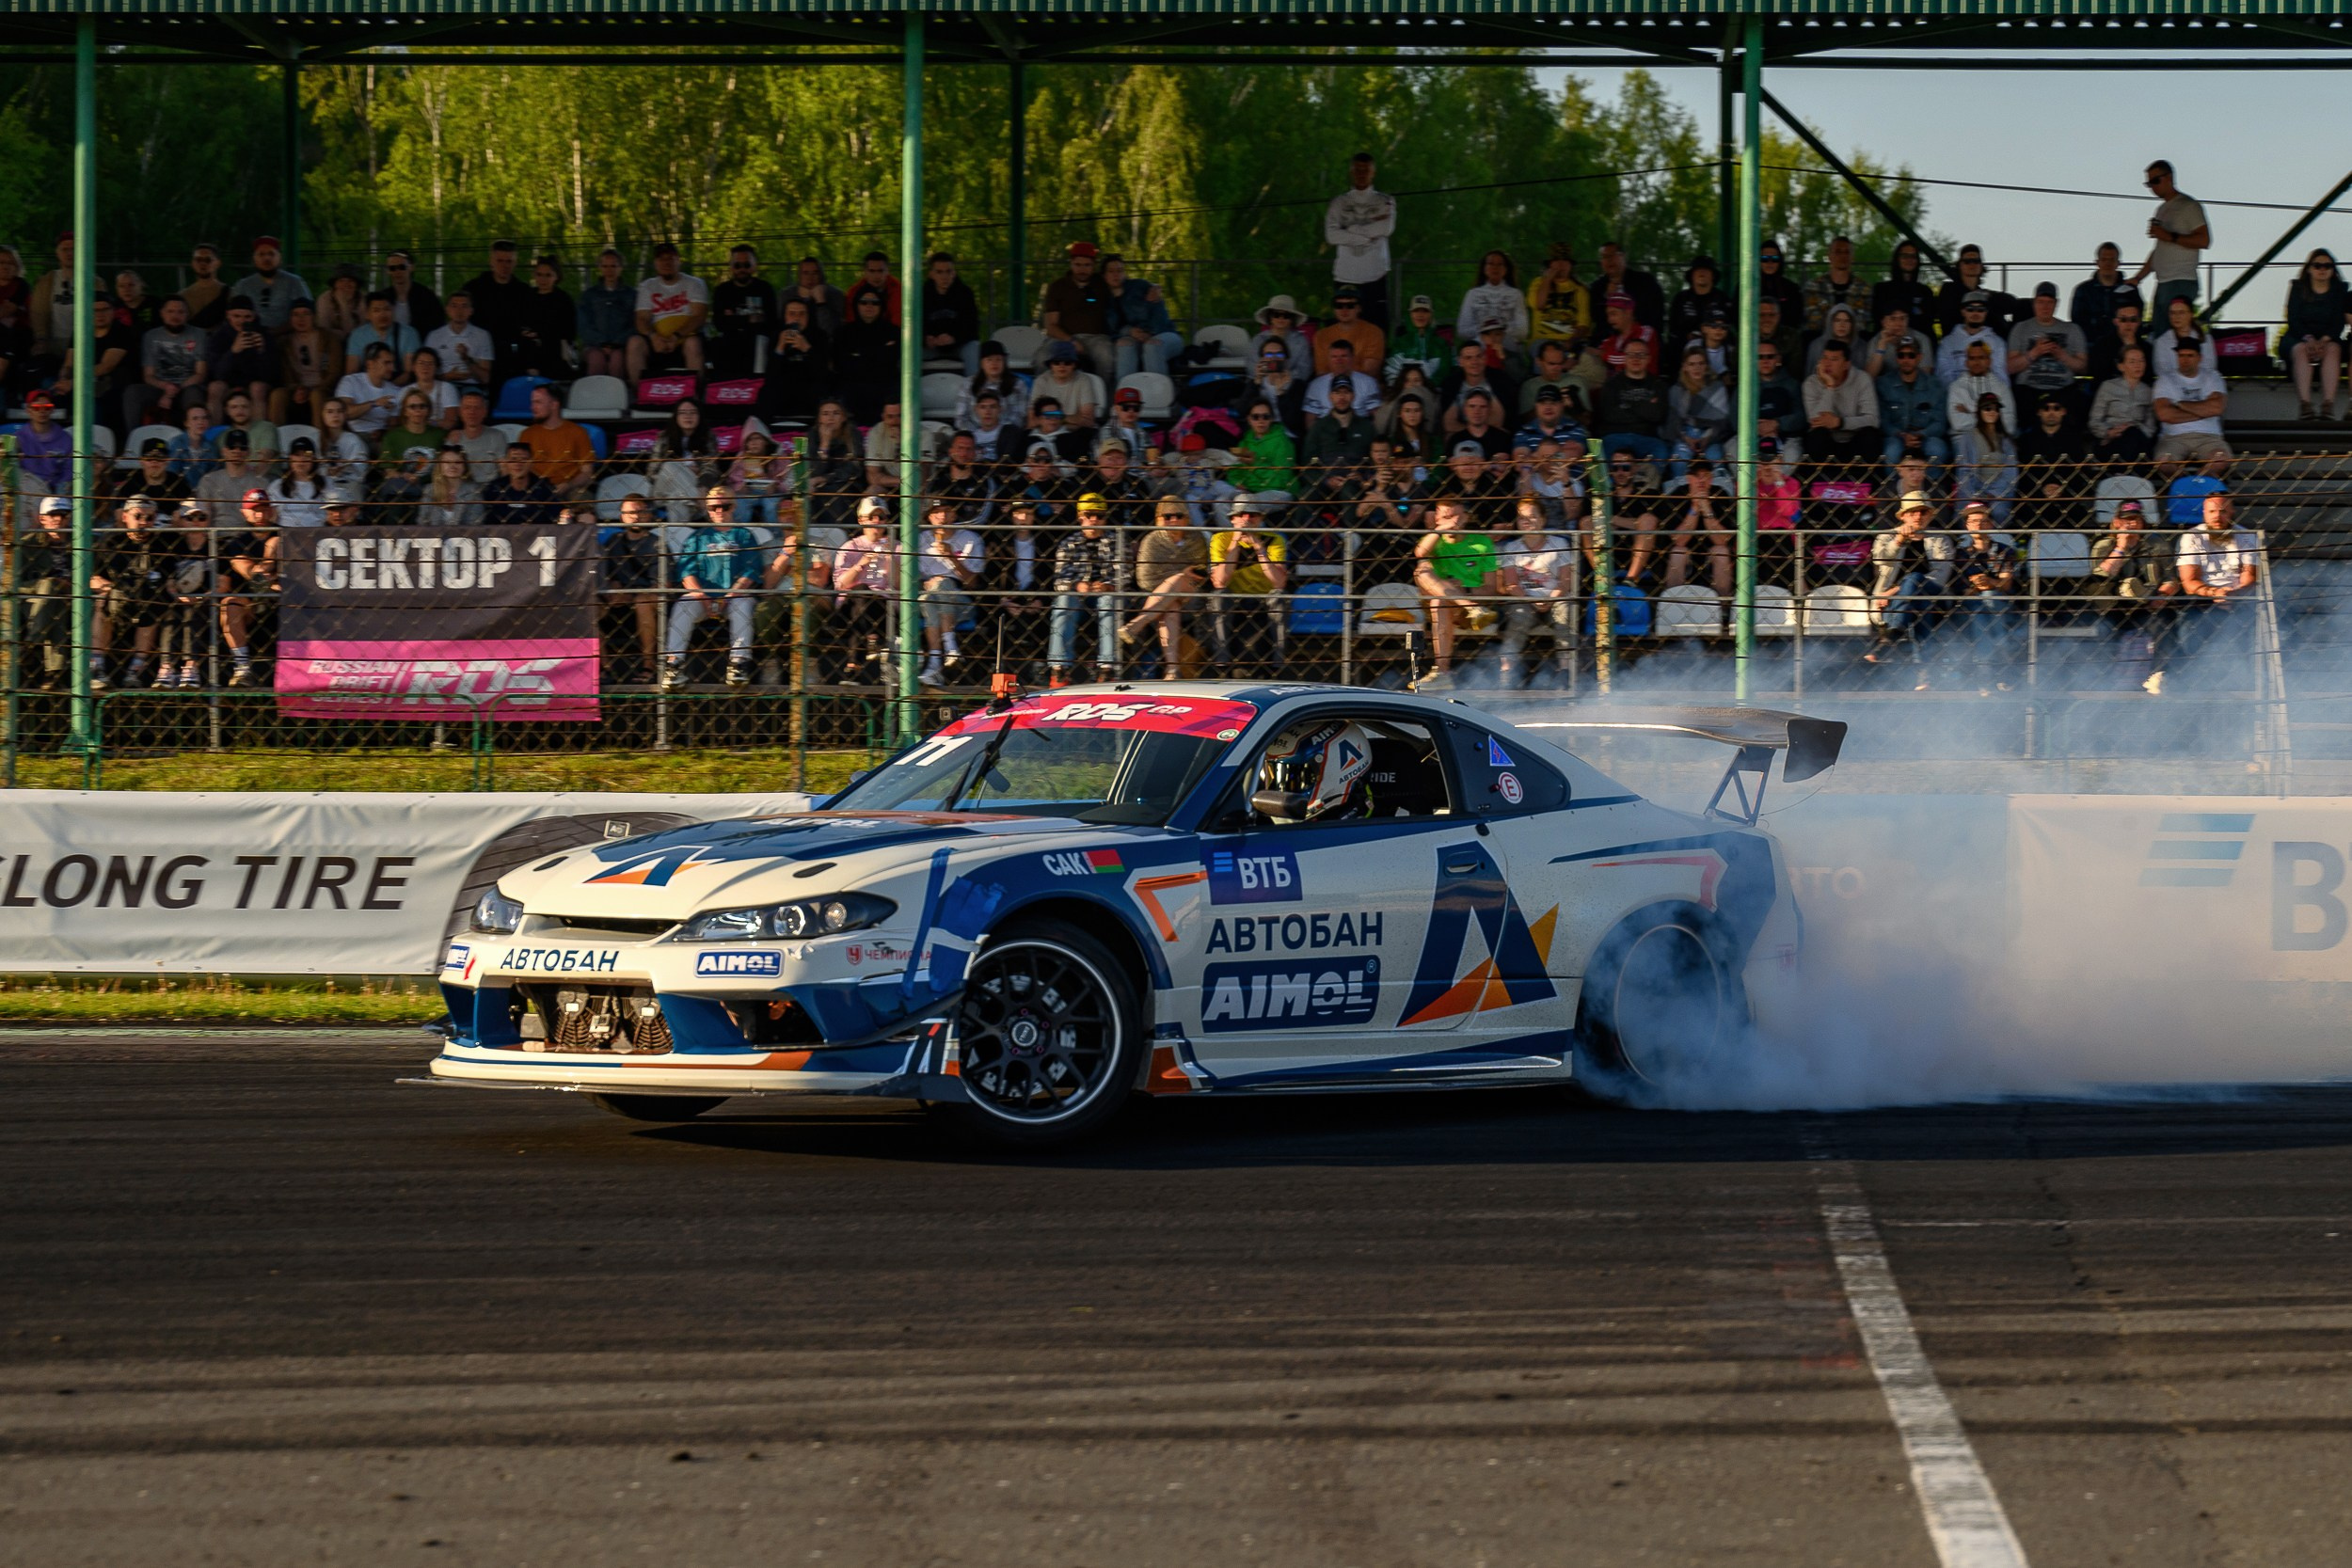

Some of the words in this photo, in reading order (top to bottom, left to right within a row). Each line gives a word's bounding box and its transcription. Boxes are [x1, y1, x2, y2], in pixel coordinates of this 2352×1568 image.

[315, 537, 513, 590] СЕКТОР
[527, 536, 558, 587] 1
[307, 659, 400, 674] RUSSIAN
[329, 675, 394, 689] DRIFT
[402, 659, 564, 705] RDS
[1041, 704, 1157, 721] RDS
[1147, 705, 1193, 716] GP
[1504, 779, 1518, 797] E
[1042, 851, 1089, 877] САК
[1237, 856, 1293, 890] ВТБ
[234, 855, 417, 911] TIRE
[1205, 911, 1384, 955] АВТОБАН
[501, 948, 620, 972] АВТОБАН
[697, 954, 779, 973] AIMOL
[1202, 970, 1374, 1022] AIMOL
